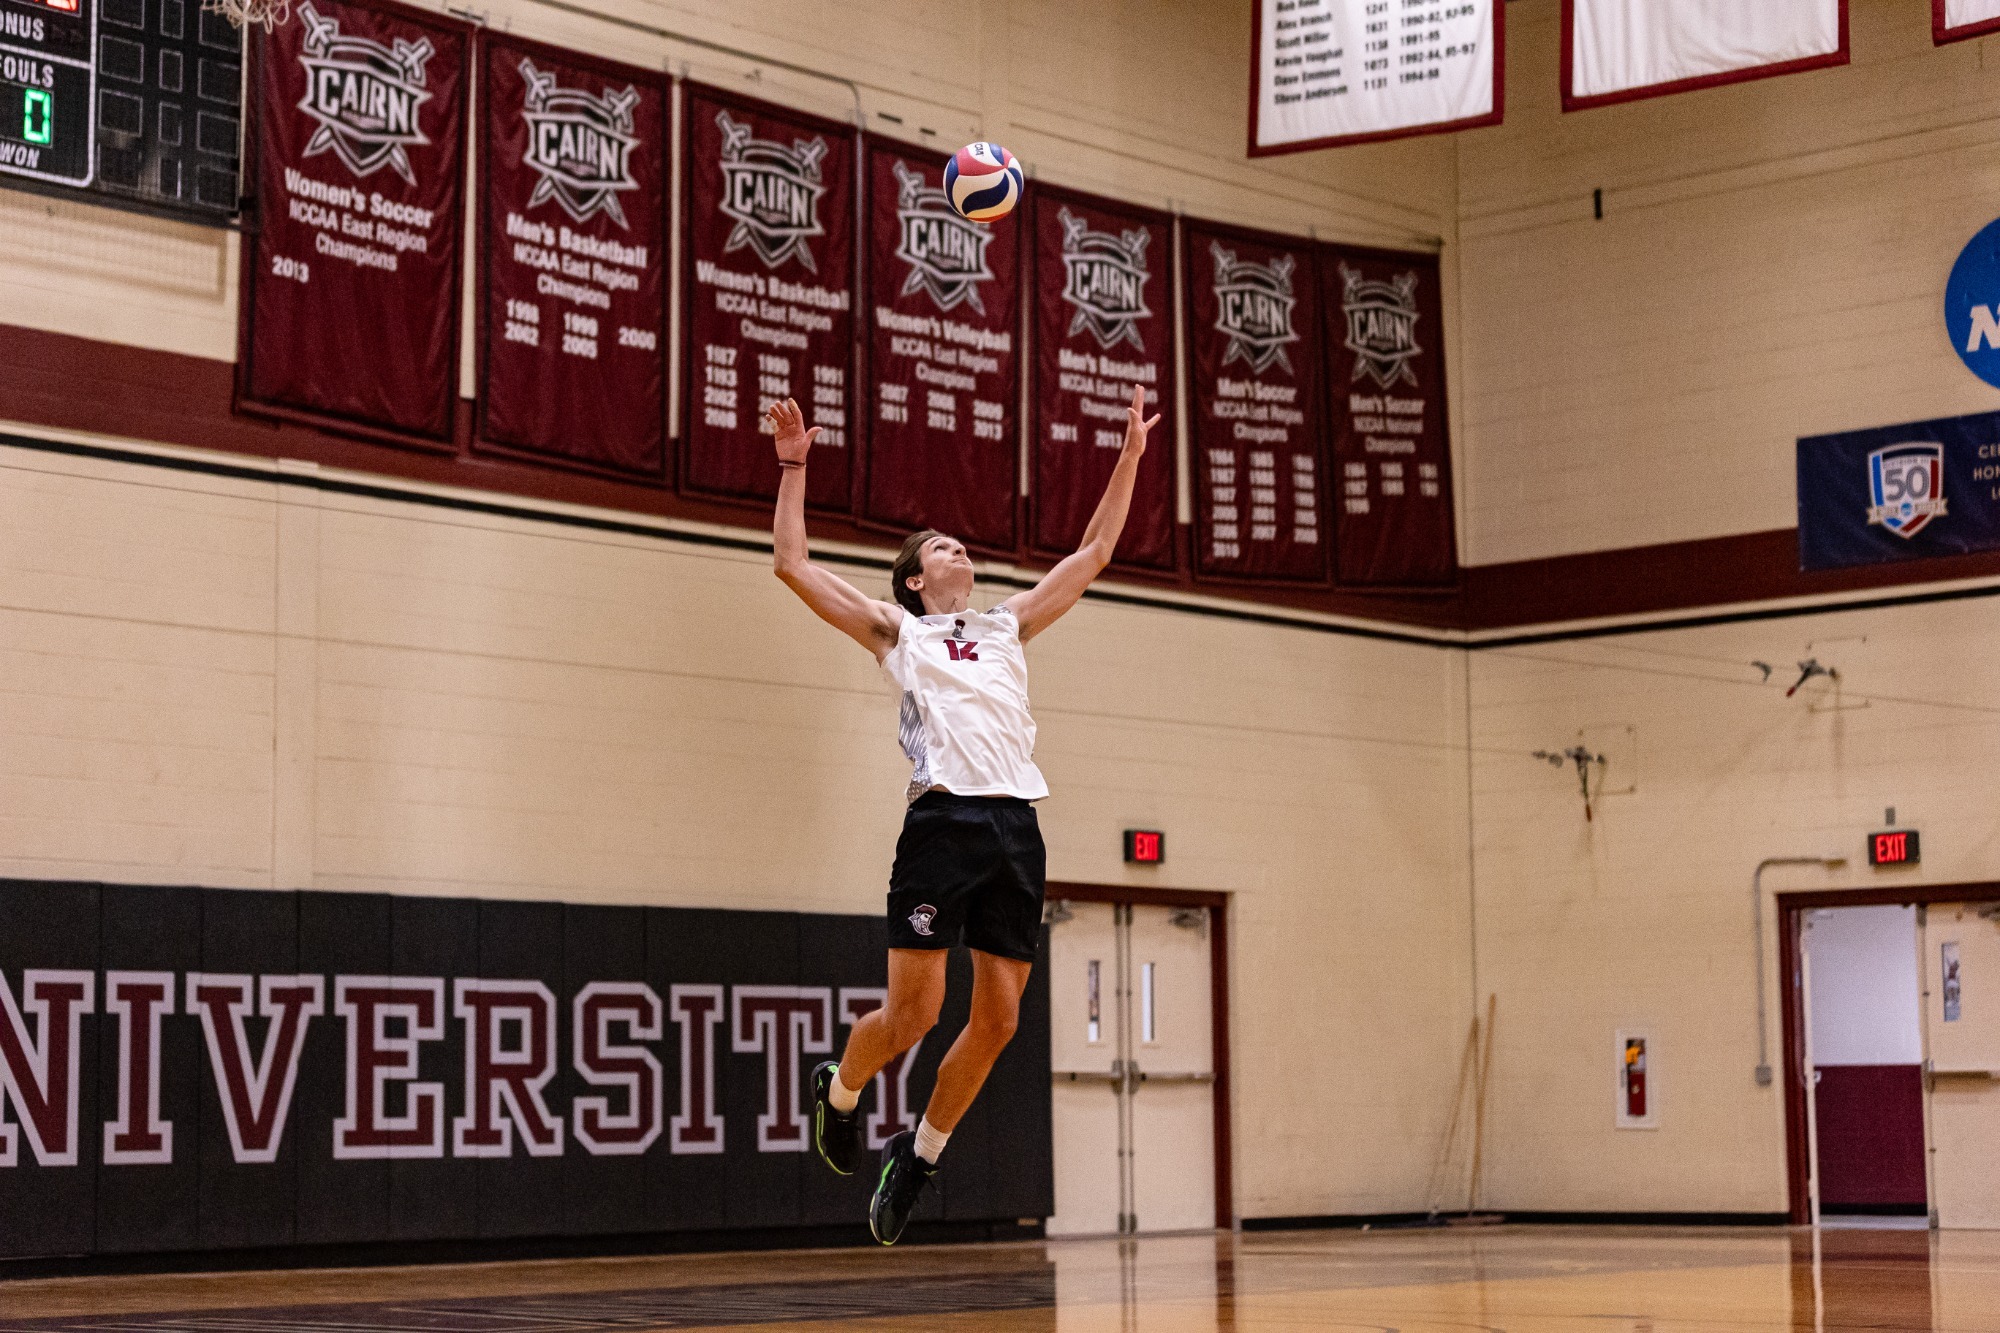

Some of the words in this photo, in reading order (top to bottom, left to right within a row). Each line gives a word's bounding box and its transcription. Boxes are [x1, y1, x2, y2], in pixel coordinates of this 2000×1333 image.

[0, 54, 54, 88] OULS
[24, 88, 50, 144] 0
[318, 68, 409, 133] CAIRN
[0, 141, 40, 168] WON
[538, 120, 619, 180] CAIRN
[285, 166, 366, 212] Women's
[370, 192, 434, 228] Soccer
[734, 172, 808, 226] CAIRN
[289, 198, 338, 231] NCCAA
[342, 212, 374, 240] East
[376, 222, 427, 253] Region
[506, 212, 556, 246] Men's
[560, 226, 647, 268] Basketball
[910, 219, 977, 270] CAIRN
[272, 255, 309, 283] 2013
[316, 232, 398, 272] Champions
[514, 242, 560, 271] NCCAA
[562, 254, 590, 280] East
[592, 262, 638, 290] Region
[537, 273, 610, 310] Champions
[696, 260, 766, 296] Women's
[768, 276, 850, 310] Basketball
[1076, 262, 1136, 310] CAIRN
[716, 291, 758, 316] NCCAA
[760, 300, 787, 322] East
[789, 306, 832, 332] Region
[876, 306, 941, 338] Women's
[942, 319, 1010, 352] Volleyball
[1226, 292, 1284, 334] CAIRN
[1354, 310, 1408, 349] CAIRN
[740, 318, 808, 349] Champions
[1059, 348, 1096, 374] Men's
[1081, 397, 1128, 422] Champion
[1254, 380, 1296, 402] Soccer
[1886, 466, 1930, 501] 50
[943, 639, 980, 662] 12
[1876, 832, 1906, 862] EXIT
